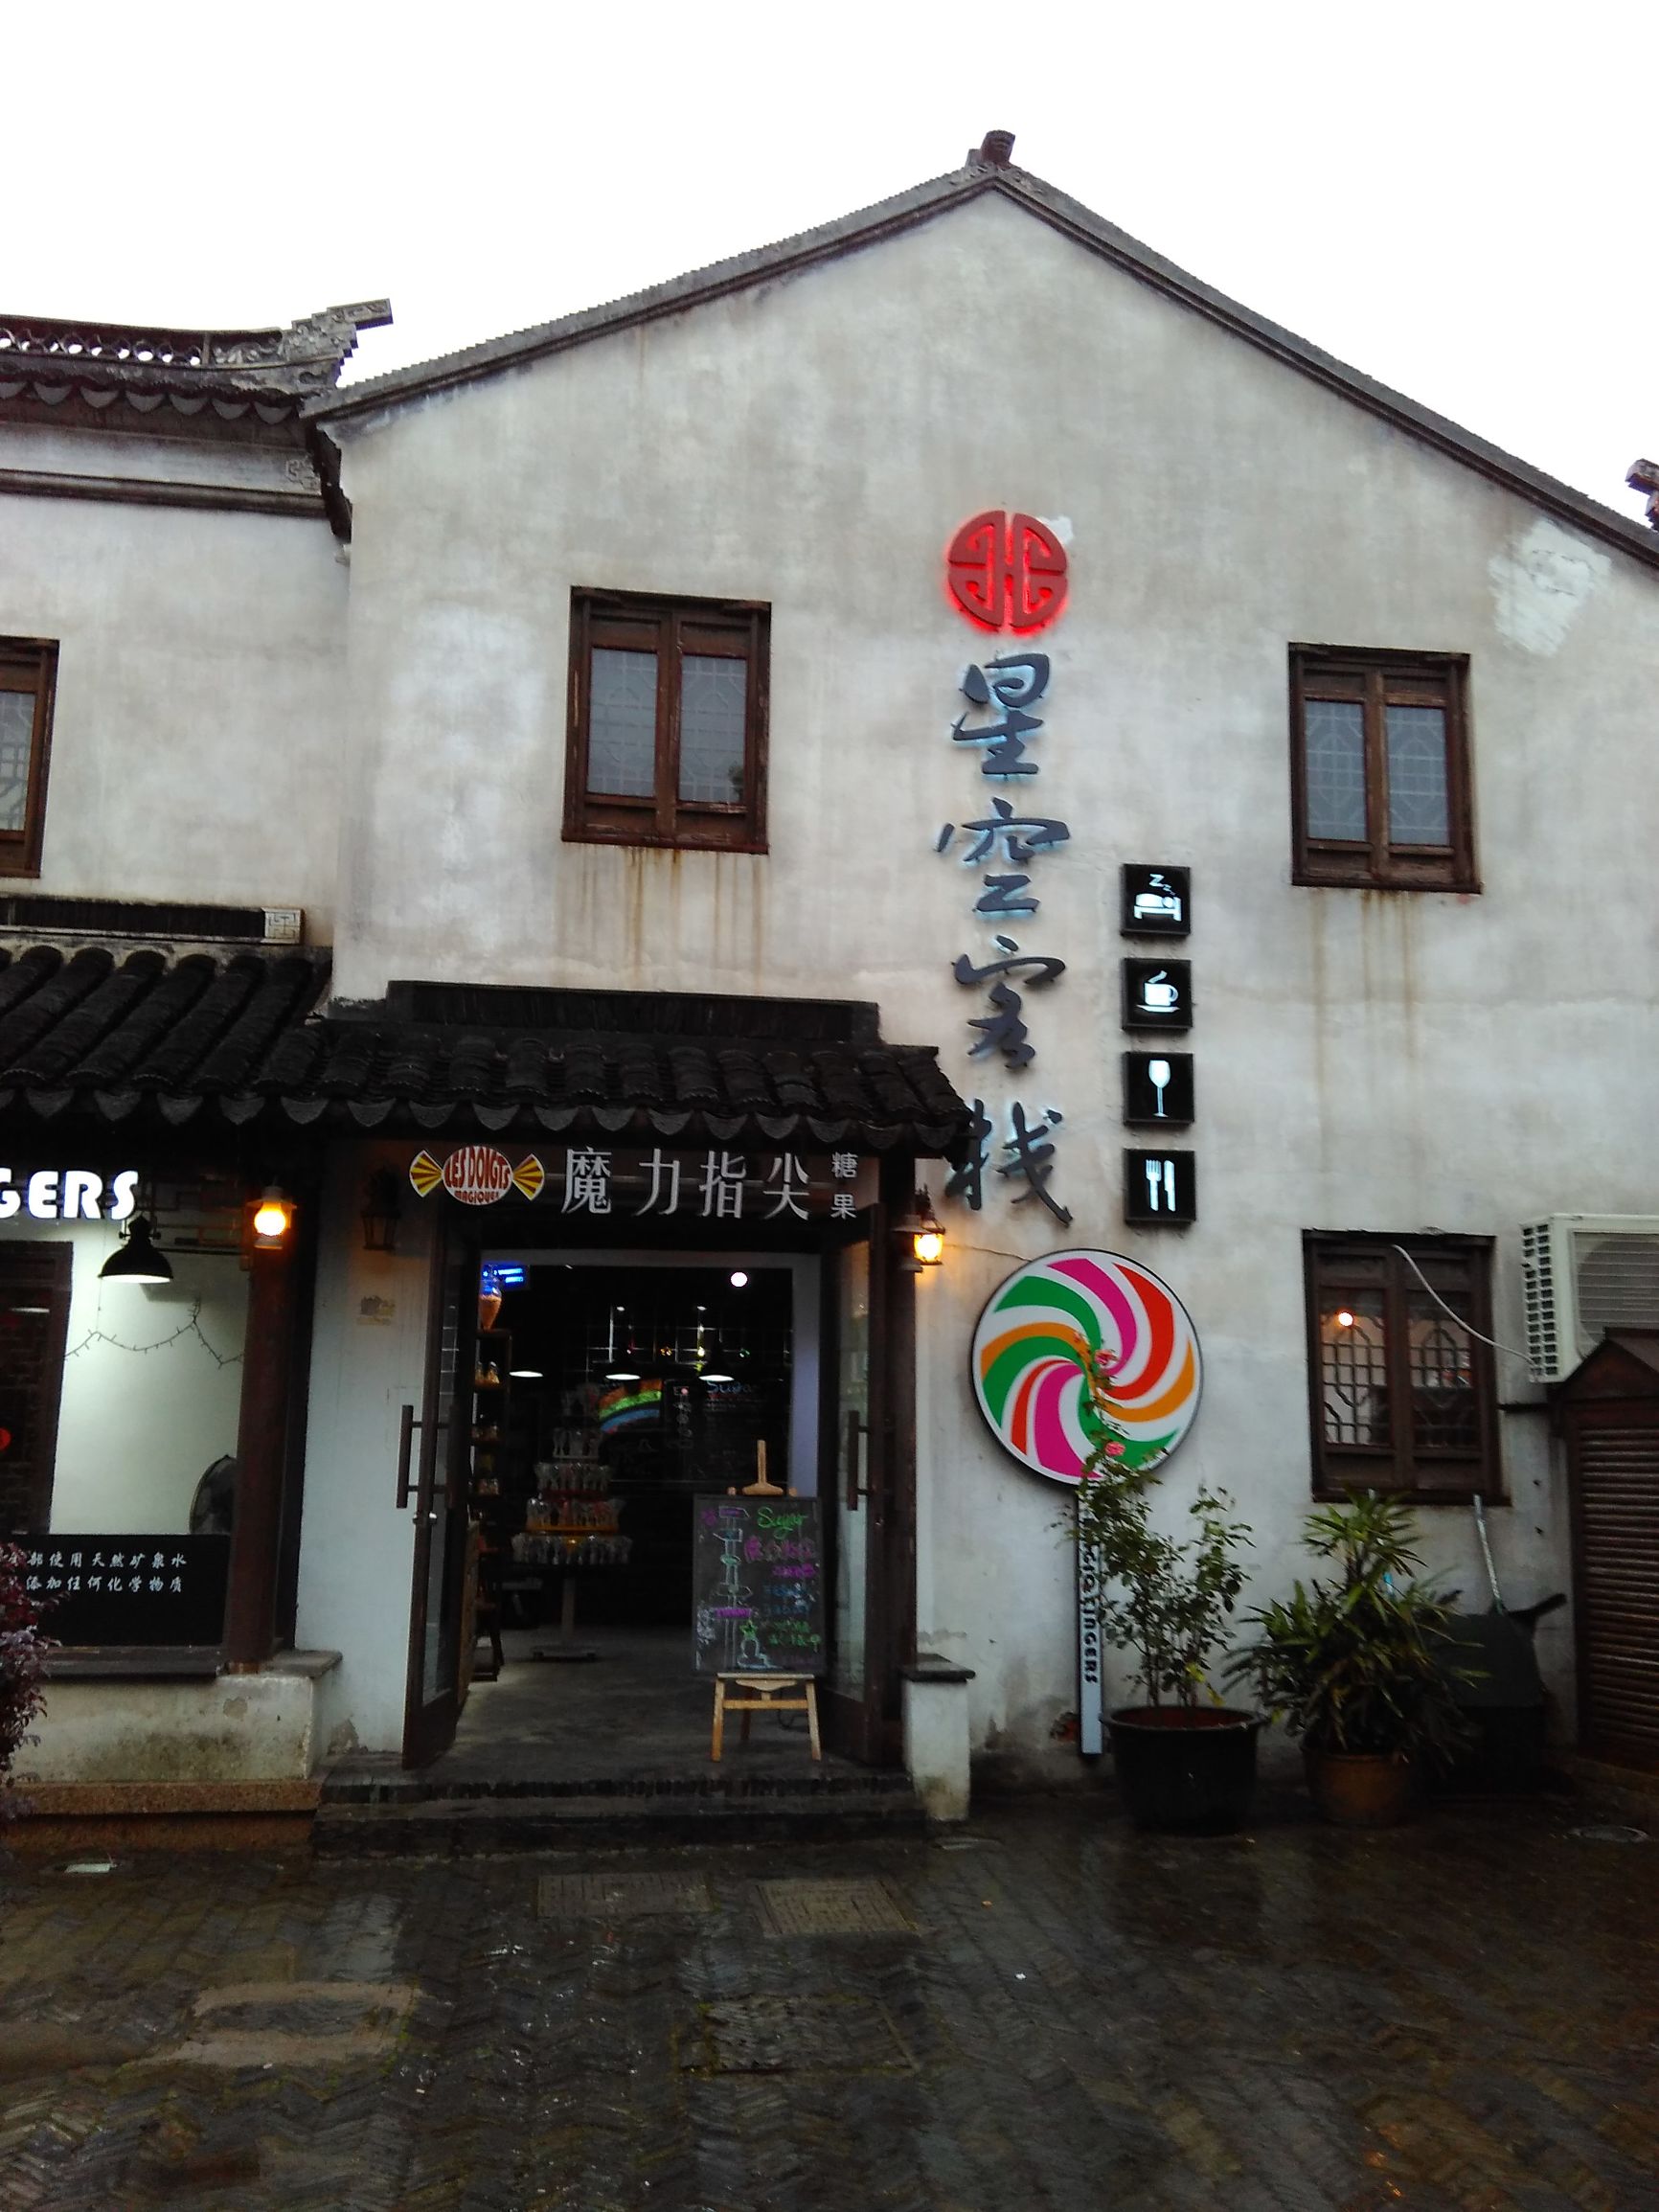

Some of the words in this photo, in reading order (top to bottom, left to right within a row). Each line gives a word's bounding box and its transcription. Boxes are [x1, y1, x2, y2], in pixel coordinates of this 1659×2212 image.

[938, 652, 1074, 1228] 星空客栈
[444, 1148, 466, 1188] LES
[467, 1146, 511, 1190] DOIGTS
[561, 1147, 810, 1220] 魔力指尖
[830, 1152, 858, 1220] 糖果
[10, 1575, 183, 1593] 添加任何化学物质
